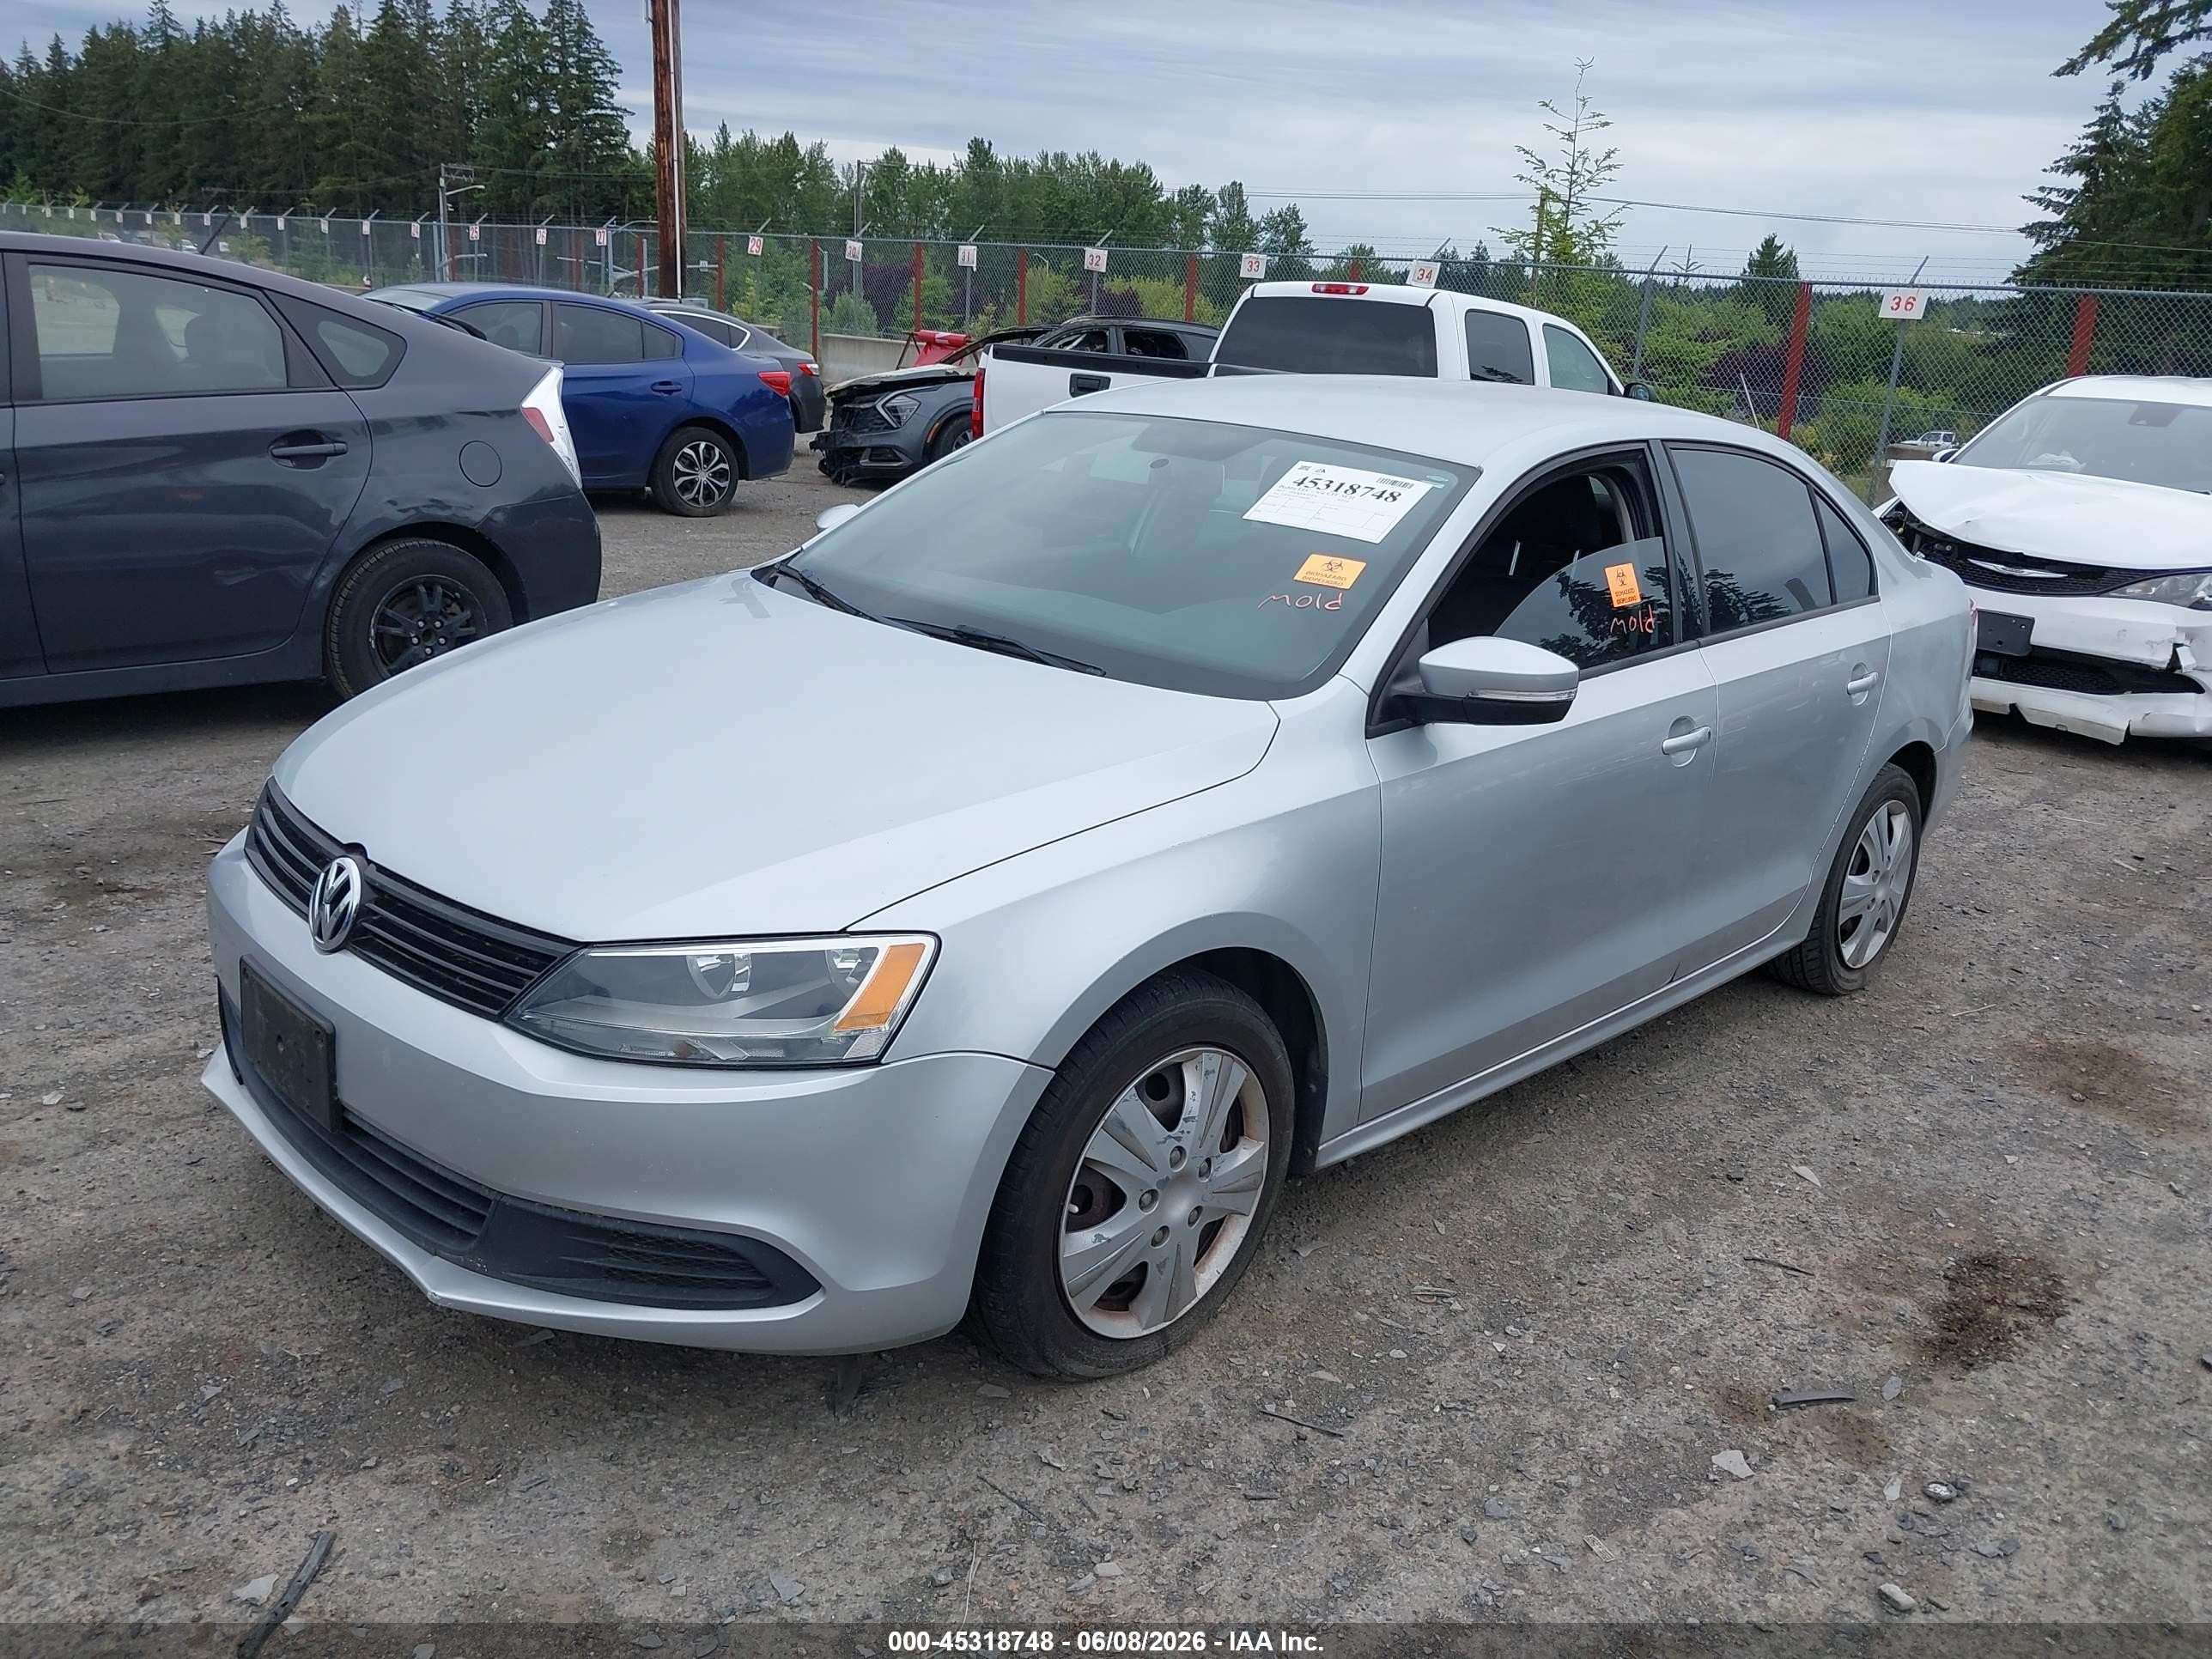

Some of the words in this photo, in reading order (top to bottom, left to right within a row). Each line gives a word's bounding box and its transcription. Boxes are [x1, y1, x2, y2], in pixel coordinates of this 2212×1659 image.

[470, 227, 478, 240] 25
[538, 231, 545, 244] 26
[598, 231, 605, 245] 27
[750, 237, 762, 253] 29
[961, 251, 970, 262] 31
[1089, 253, 1101, 267] 32
[1247, 260, 1261, 272] 33
[1417, 267, 1433, 282] 34
[1890, 295, 1917, 312] 36
[1292, 476, 1401, 504] 45318748
